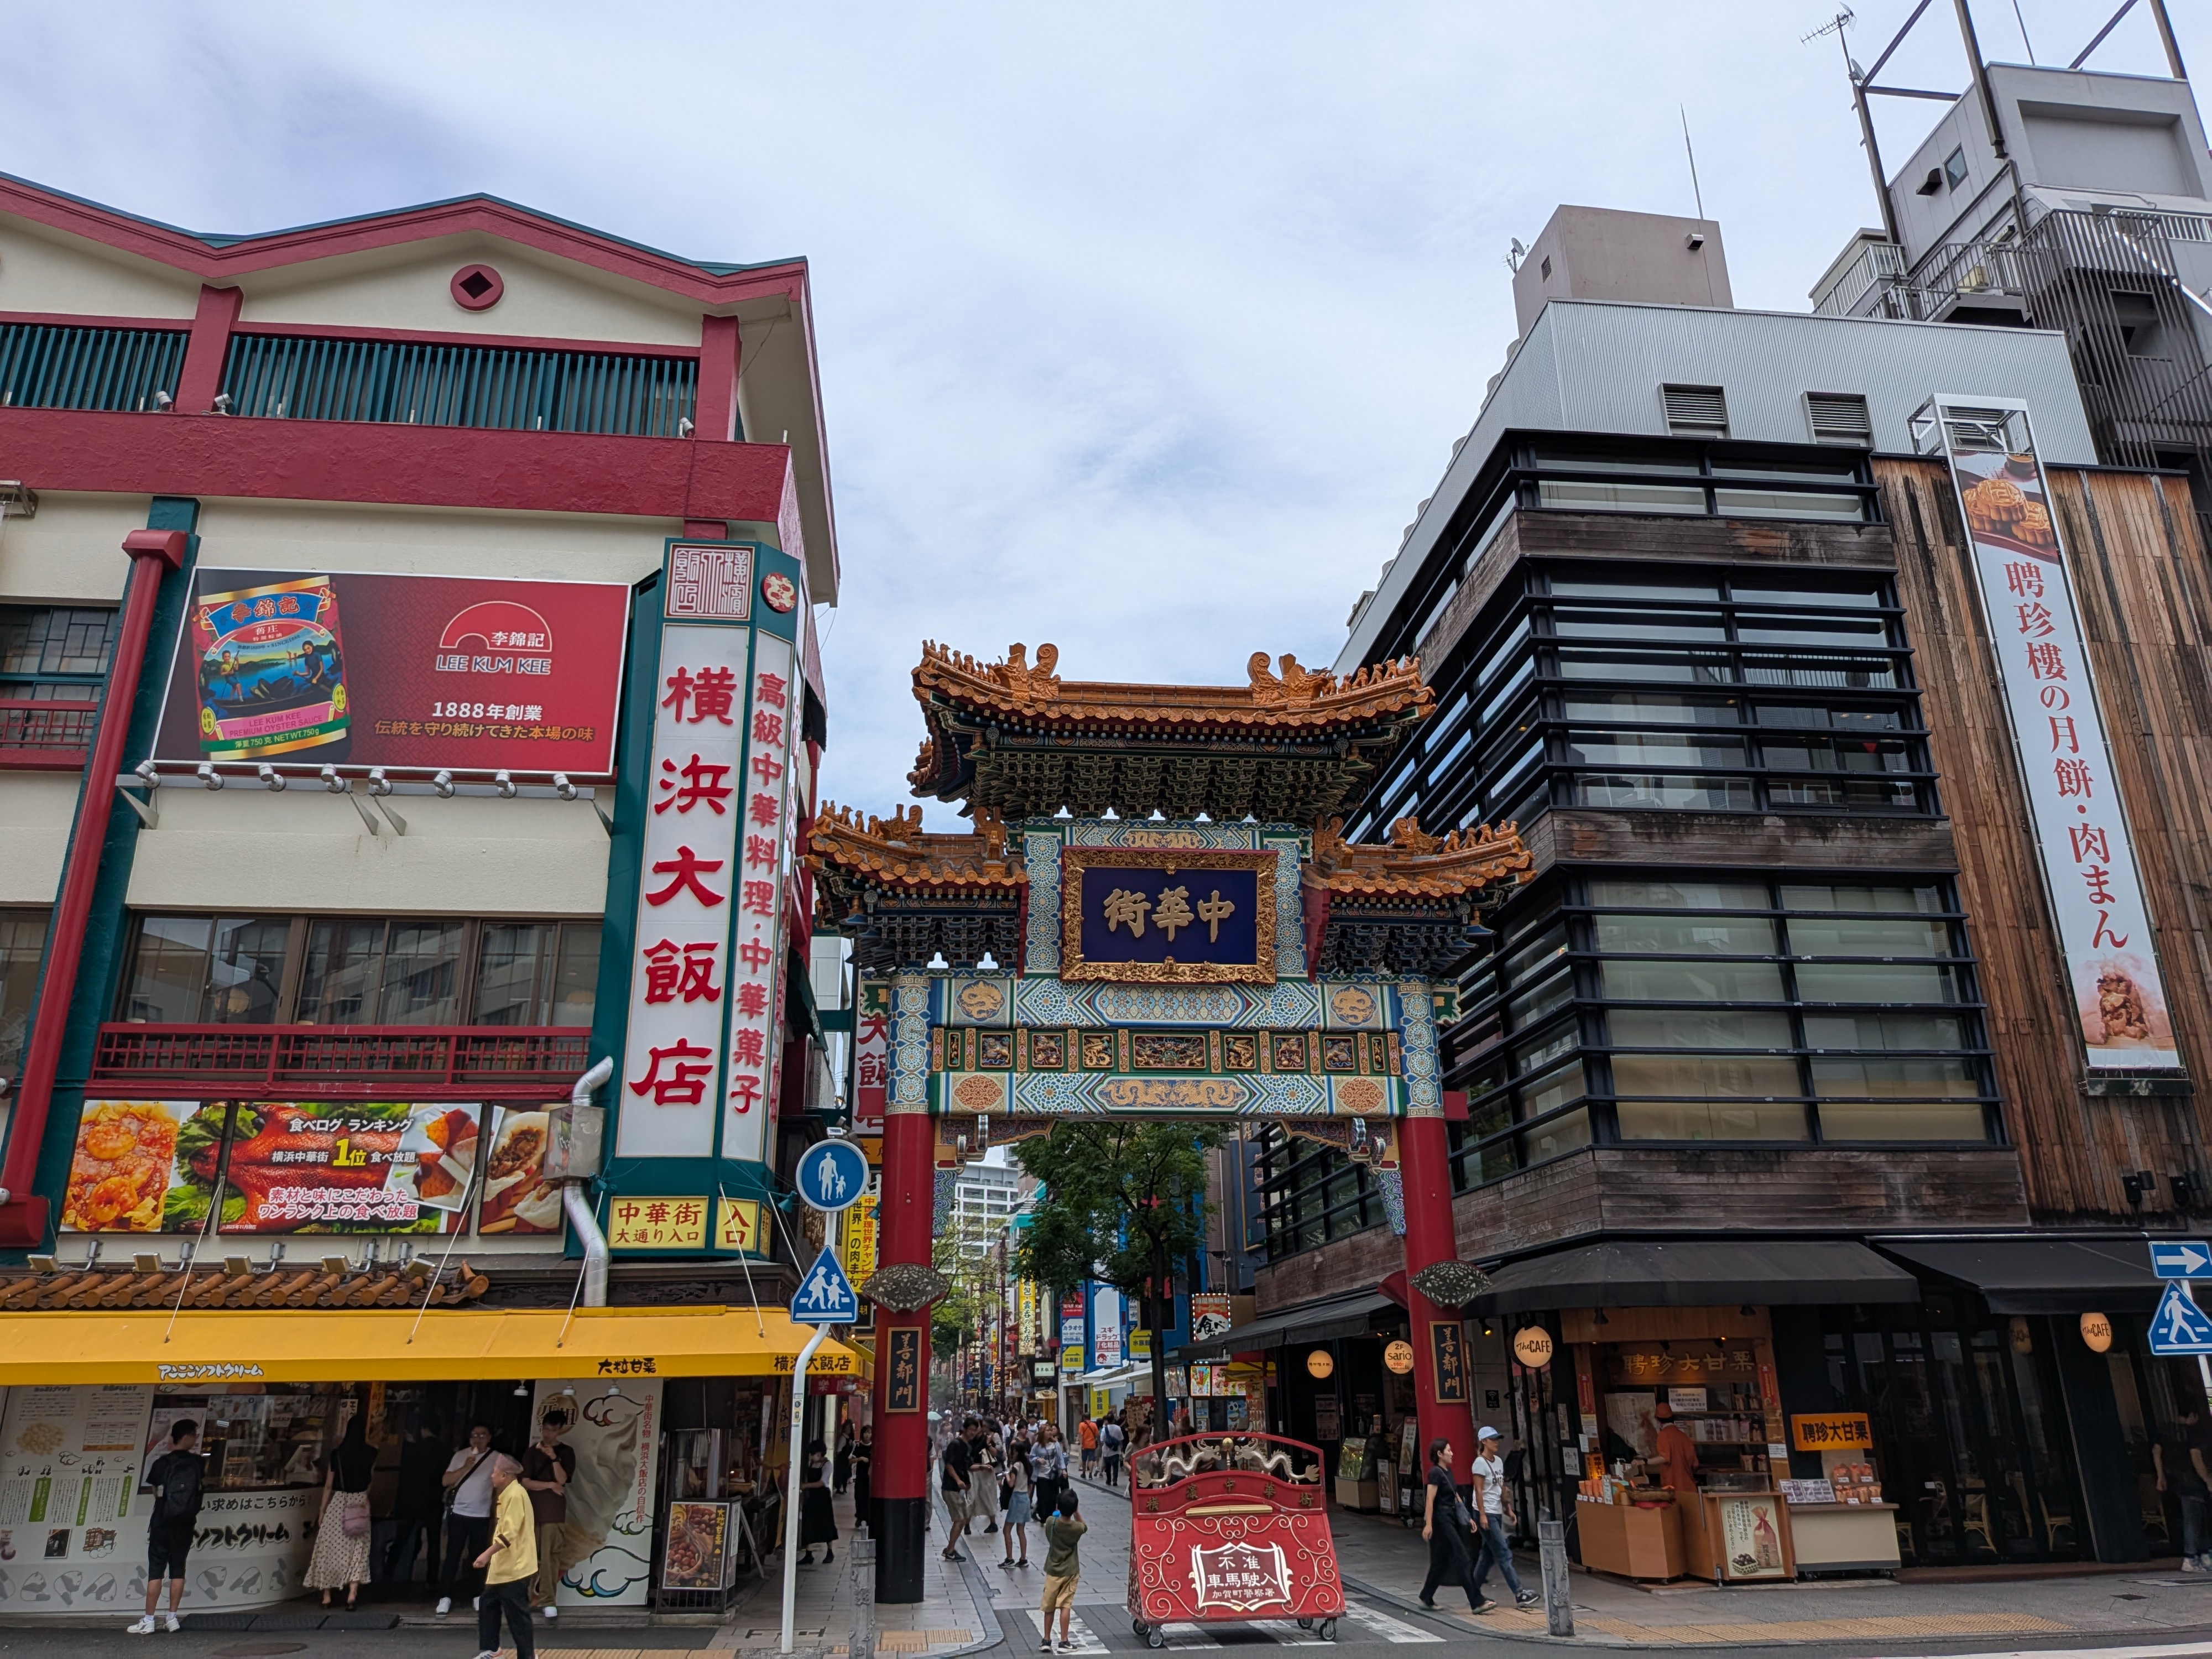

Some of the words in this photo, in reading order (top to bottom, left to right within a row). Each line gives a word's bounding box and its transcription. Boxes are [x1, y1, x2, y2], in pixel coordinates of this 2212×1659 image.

[231, 596, 300, 623] 李錦記
[491, 631, 545, 648] 李錦記
[436, 655, 468, 671] LEE
[472, 656, 513, 673] KUM
[517, 658, 552, 675] KEE
[249, 718, 264, 727] LEE
[265, 716, 284, 724] KUM
[286, 712, 301, 721] KEE
[432, 701, 544, 721] 1888年創業
[229, 727, 263, 738] PREMIUM
[264, 722, 296, 733] OYSTER
[299, 714, 322, 726] SAUCE
[374, 720, 594, 741] 伝統を守り続けてきた本場の味
[274, 733, 289, 742] NET
[629, 666, 738, 1107] 横浜大飯店
[731, 672, 788, 1114] 高級中華料理・中華菓子
[289, 1118, 345, 1132] 食べログ
[348, 1118, 414, 1132] ランキング
[272, 1151, 329, 1163] 横浜中華街
[332, 1138, 367, 1167] 1位
[371, 1151, 416, 1163] 食べ放題
[269, 1187, 408, 1203] 素材と味にこだわった
[258, 1203, 419, 1220] ワンランク上の食べ放題
[618, 1202, 703, 1226] 中華街
[723, 1204, 751, 1245] 入口
[615, 1228, 701, 1243] 大通り入口
[2082, 1327, 2093, 1336] The
[2091, 1323, 2110, 1337] CAFE
[1387, 1350, 1412, 1361] sario
[1516, 1341, 1531, 1353] The
[1529, 1340, 1551, 1353] CAFE
[598, 1357, 657, 1374] 大粒甘栗
[1623, 1351, 1755, 1375] 聘珍大甘栗
[641, 1394, 654, 1438] 中華街名物
[1801, 1421, 1869, 1443] 聘珍大甘栗
[636, 1442, 650, 1524] 横浜大飯店の自信作
[1218, 1555, 1261, 1571] 不准
[1207, 1572, 1278, 1588] 車馬駛入
[1212, 1588, 1275, 1599] 加賀町警察署
